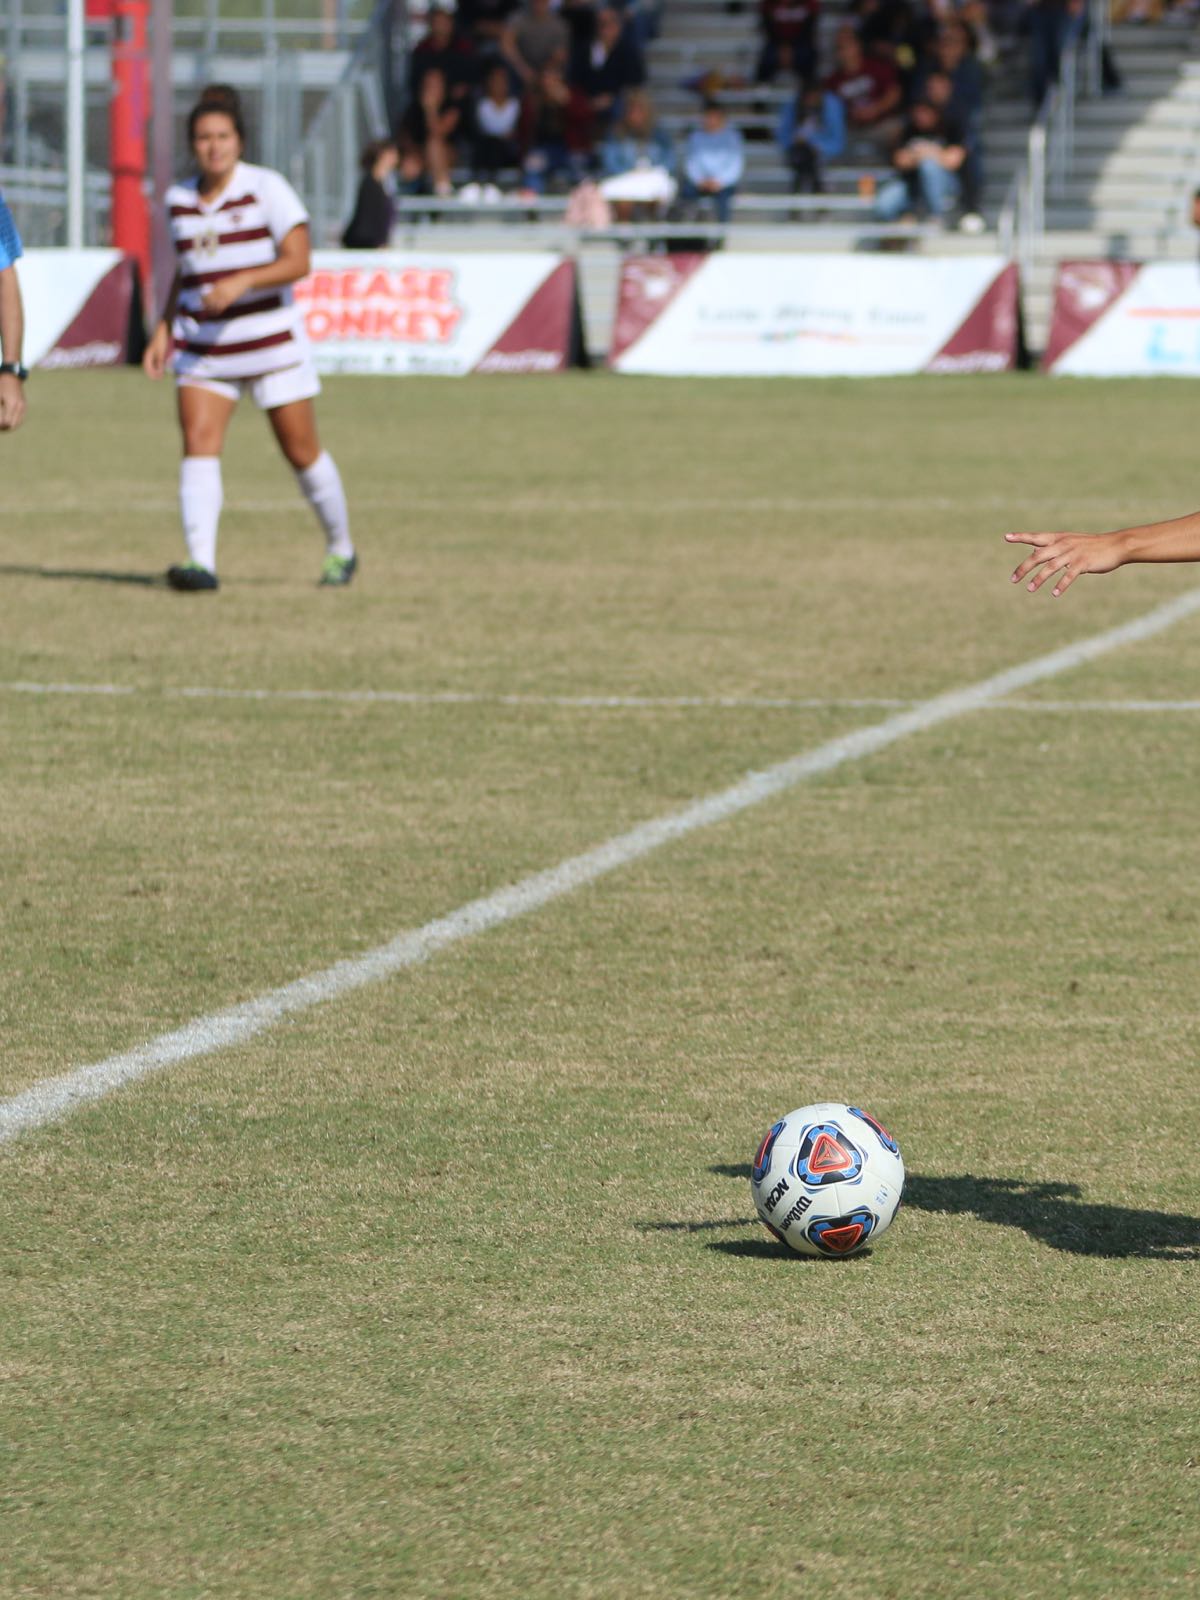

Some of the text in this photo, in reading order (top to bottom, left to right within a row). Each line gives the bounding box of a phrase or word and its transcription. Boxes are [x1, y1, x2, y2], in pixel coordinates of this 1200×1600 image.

[304, 306, 463, 342] ONKEY
[764, 1178, 790, 1213] NCAA
[779, 1195, 812, 1231] Wilson
